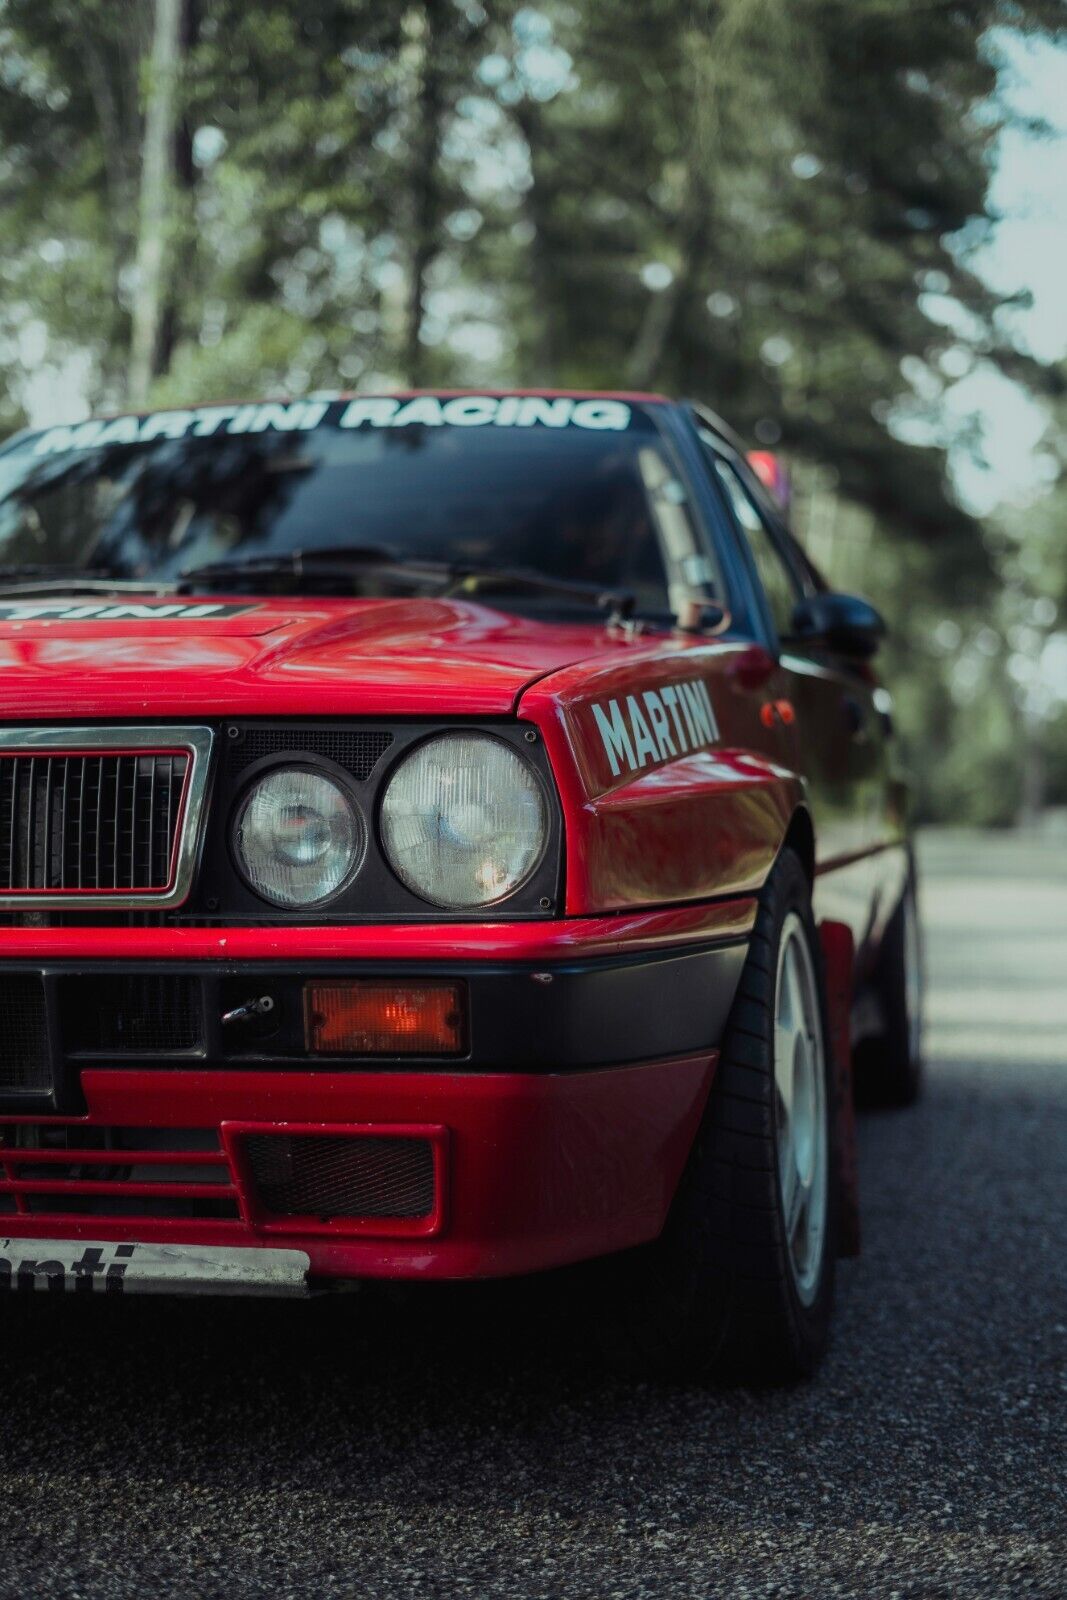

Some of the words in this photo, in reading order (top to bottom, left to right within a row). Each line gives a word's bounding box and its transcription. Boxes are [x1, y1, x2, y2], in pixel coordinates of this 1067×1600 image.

[33, 402, 330, 456] MARTINI
[339, 396, 631, 430] RACING
[591, 679, 720, 777] MARTINI
